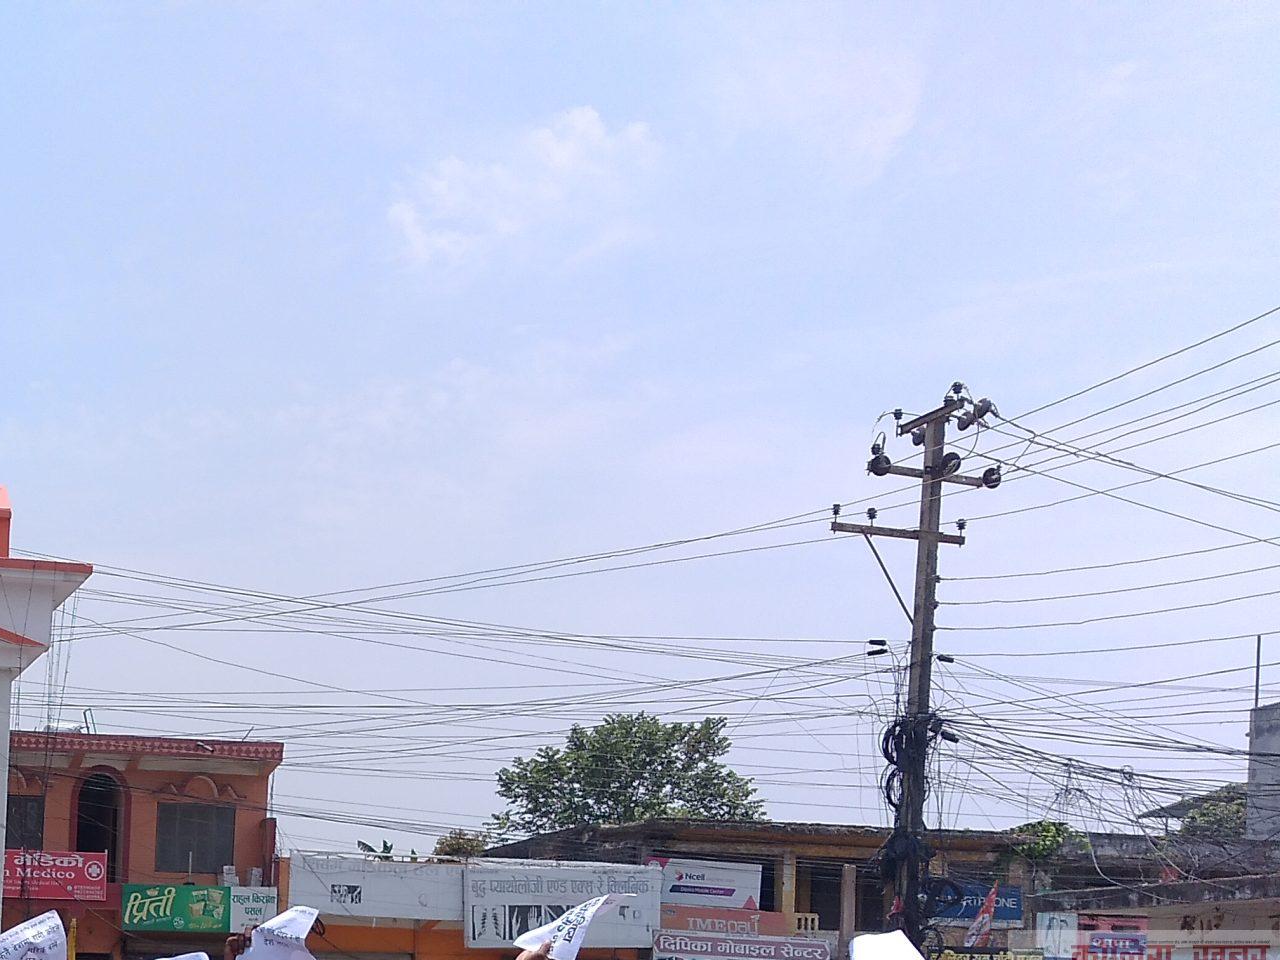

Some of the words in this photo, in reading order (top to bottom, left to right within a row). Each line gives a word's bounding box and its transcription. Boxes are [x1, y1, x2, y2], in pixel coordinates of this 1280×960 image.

[16, 867, 75, 879] Medico
[685, 872, 705, 881] Ncell
[244, 906, 263, 916] पसल
[659, 935, 713, 953] दिपिका
[717, 940, 776, 957] मोबाइल
[780, 943, 826, 960] सेन्टर
